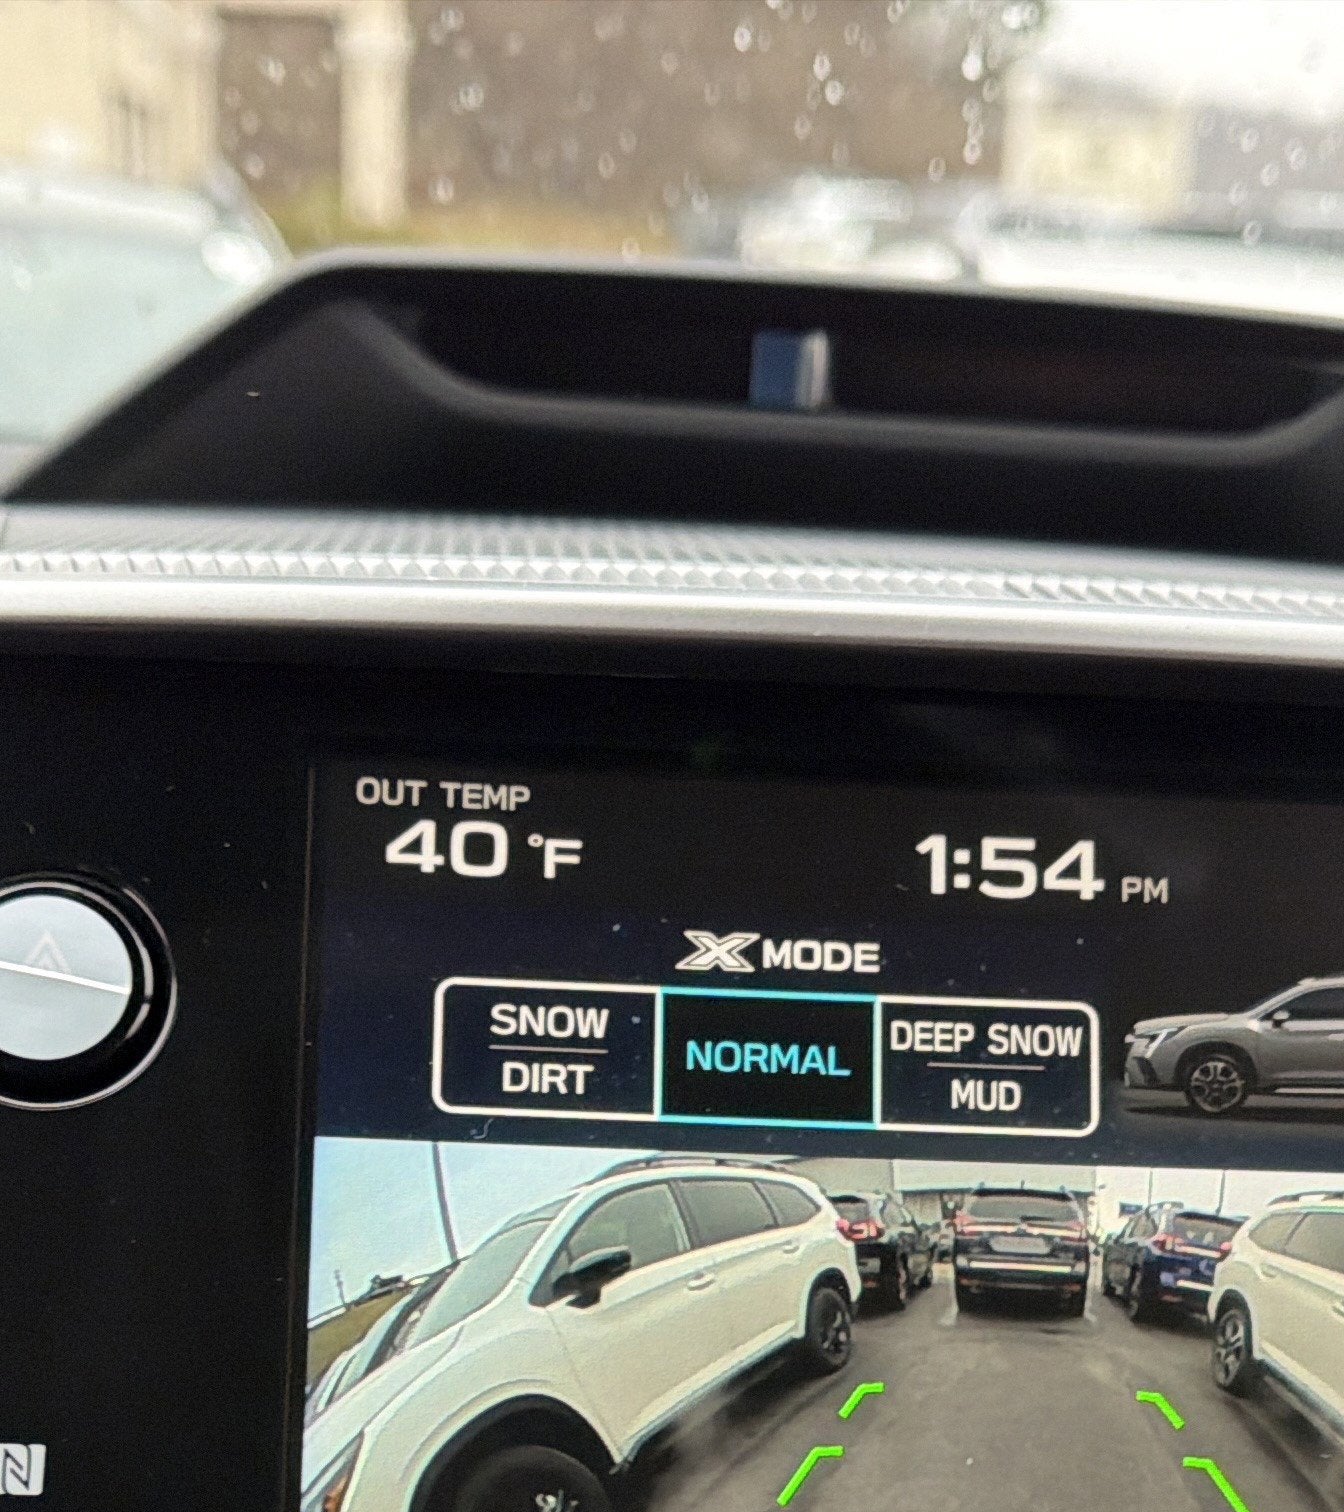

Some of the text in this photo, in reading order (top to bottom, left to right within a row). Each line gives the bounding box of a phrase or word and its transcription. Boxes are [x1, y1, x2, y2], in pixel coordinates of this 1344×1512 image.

[355, 775, 532, 812] OUT TEMP
[384, 818, 510, 879] 40
[914, 833, 1170, 905] 1:54 PM
[488, 1002, 611, 1040] SNOW
[889, 1018, 1084, 1059] DEEP SNOW
[501, 1060, 596, 1096] DIRT
[685, 1039, 853, 1079] NORMAL
[949, 1077, 1023, 1113] MUD
